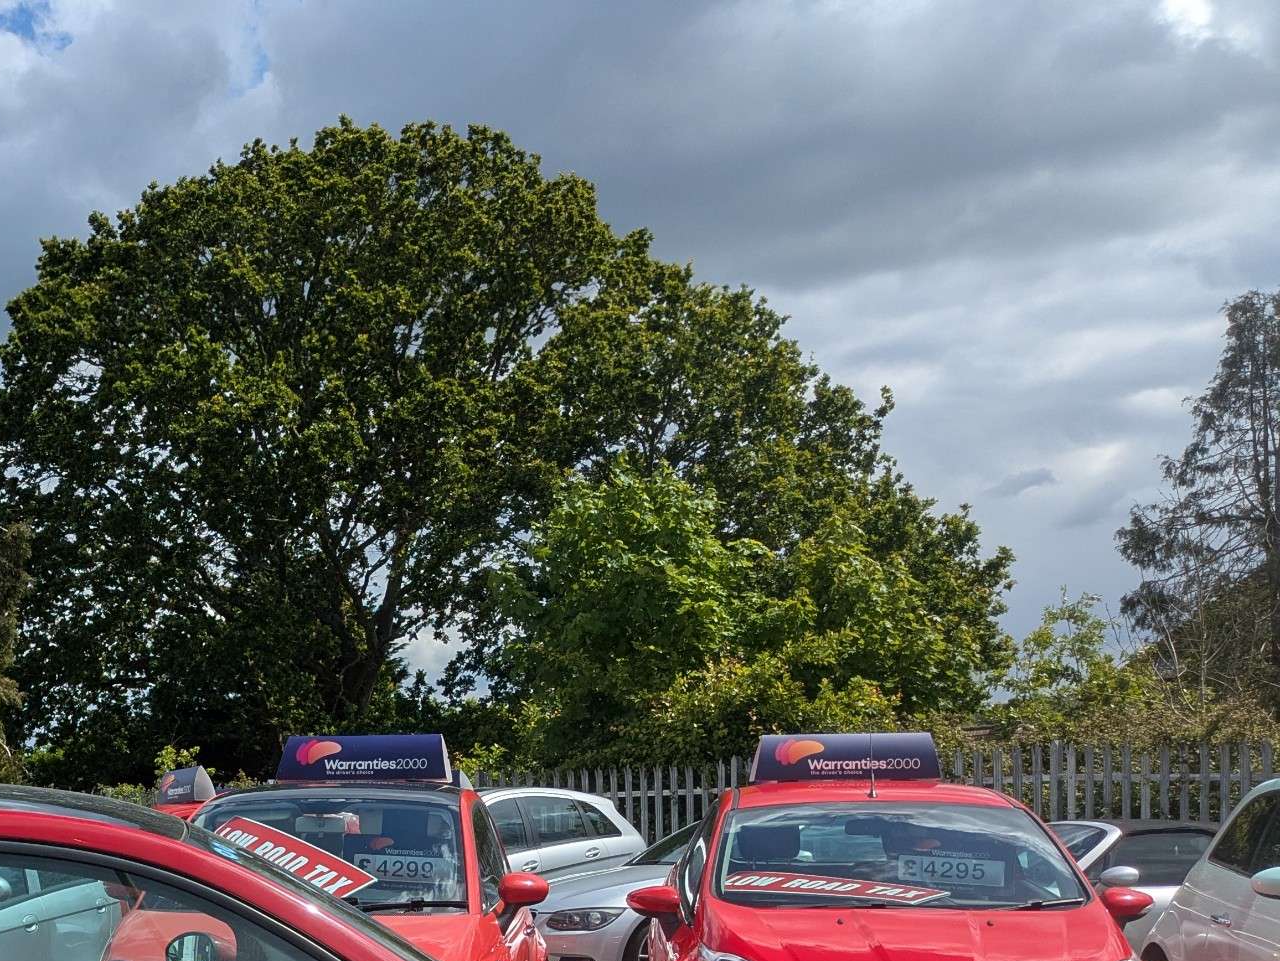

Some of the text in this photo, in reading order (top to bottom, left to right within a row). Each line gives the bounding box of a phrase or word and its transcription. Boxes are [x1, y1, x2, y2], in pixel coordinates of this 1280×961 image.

[324, 757, 428, 770] Warranties2000
[807, 757, 921, 770] Warranties2000
[303, 864, 354, 896] TAX
[725, 876, 926, 899] LOW ROAD TAX
